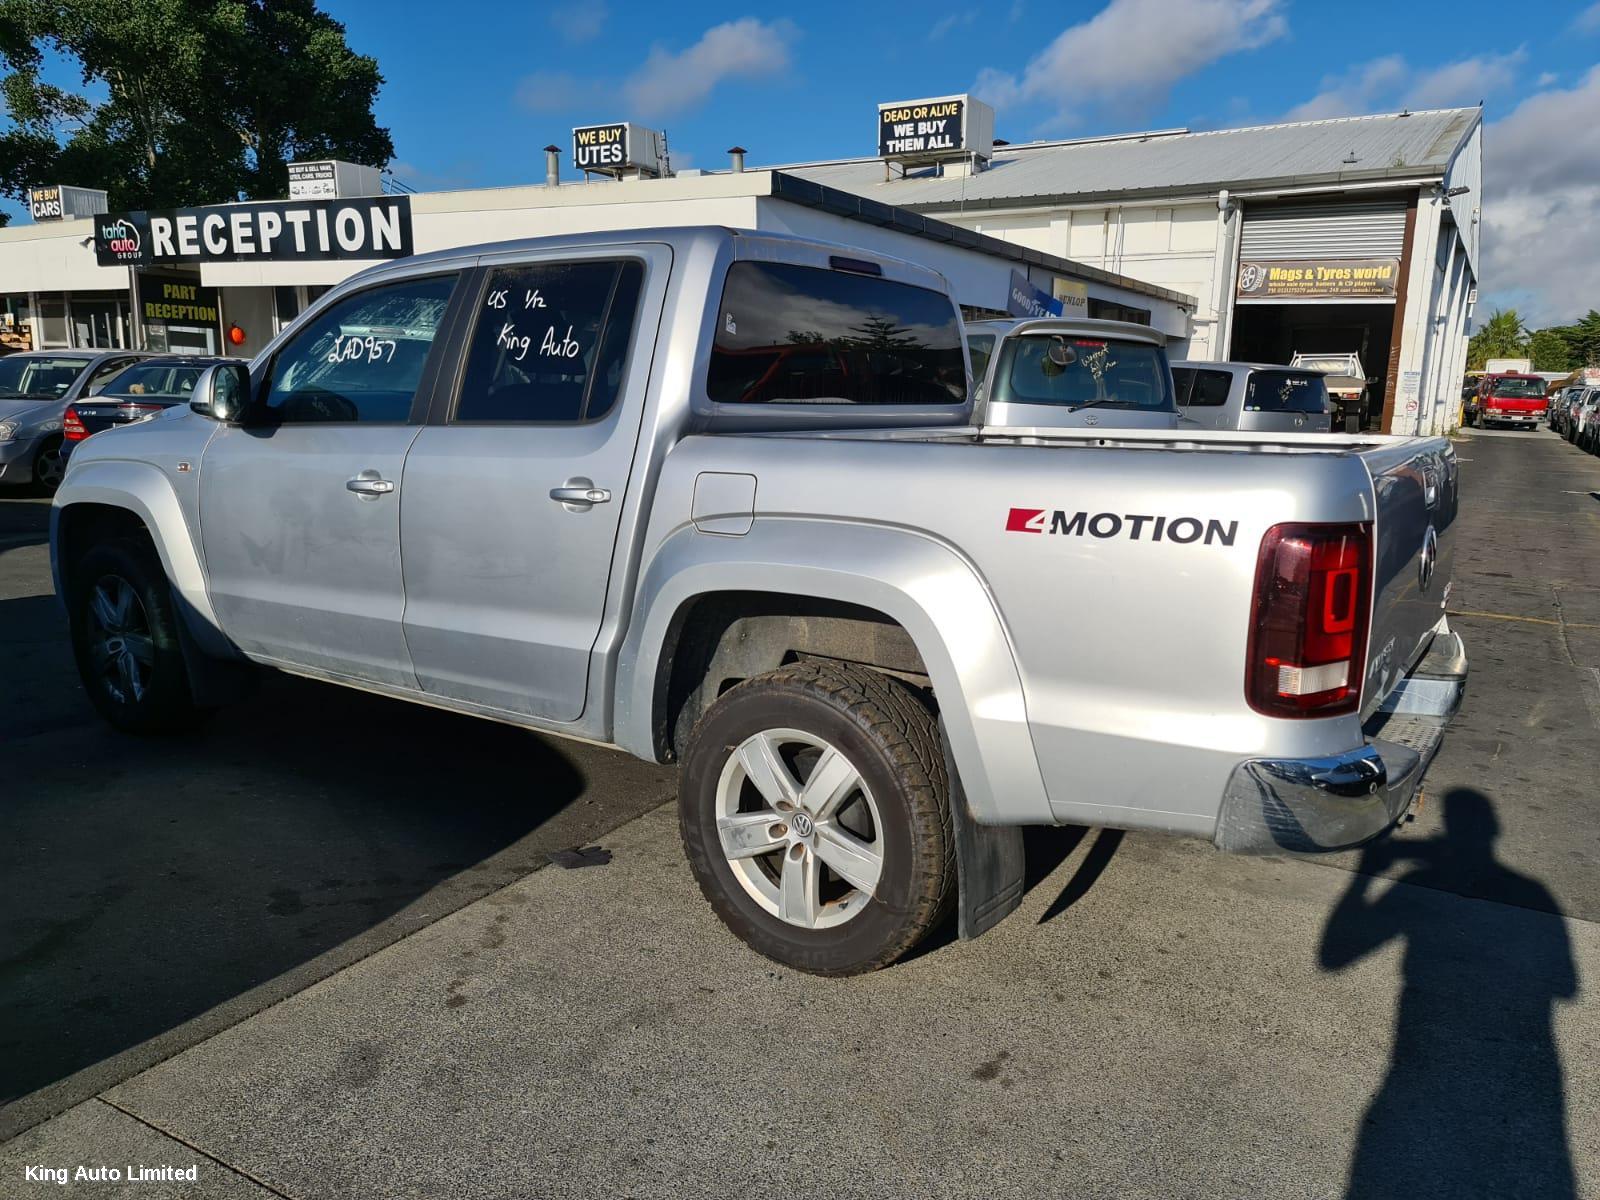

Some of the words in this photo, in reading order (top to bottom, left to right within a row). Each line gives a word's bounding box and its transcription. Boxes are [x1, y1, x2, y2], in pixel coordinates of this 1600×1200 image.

[884, 108, 910, 122] DEAD
[913, 106, 928, 118] OR
[930, 103, 958, 117] ALIVE
[578, 131, 596, 144] WE
[599, 128, 621, 143] BUY
[894, 123, 914, 137] WE
[918, 120, 946, 134] BUY
[886, 137, 924, 152] THEM
[928, 134, 954, 150] ALL
[578, 144, 622, 165] UTES
[33, 191, 43, 201] WE
[44, 189, 58, 199] BUY
[33, 201, 60, 217] CARS
[102, 223, 126, 239] taha
[150, 206, 402, 256] RECEPTION
[111, 238, 136, 252] auto
[1269, 267, 1302, 281] Mags
[1305, 268, 1314, 279] &
[1316, 266, 1351, 281] Tyres
[1353, 265, 1391, 279] world
[163, 284, 196, 300] PART
[145, 302, 217, 322] RECEPTION
[497, 322, 530, 360] King
[540, 325, 579, 357] Auto
